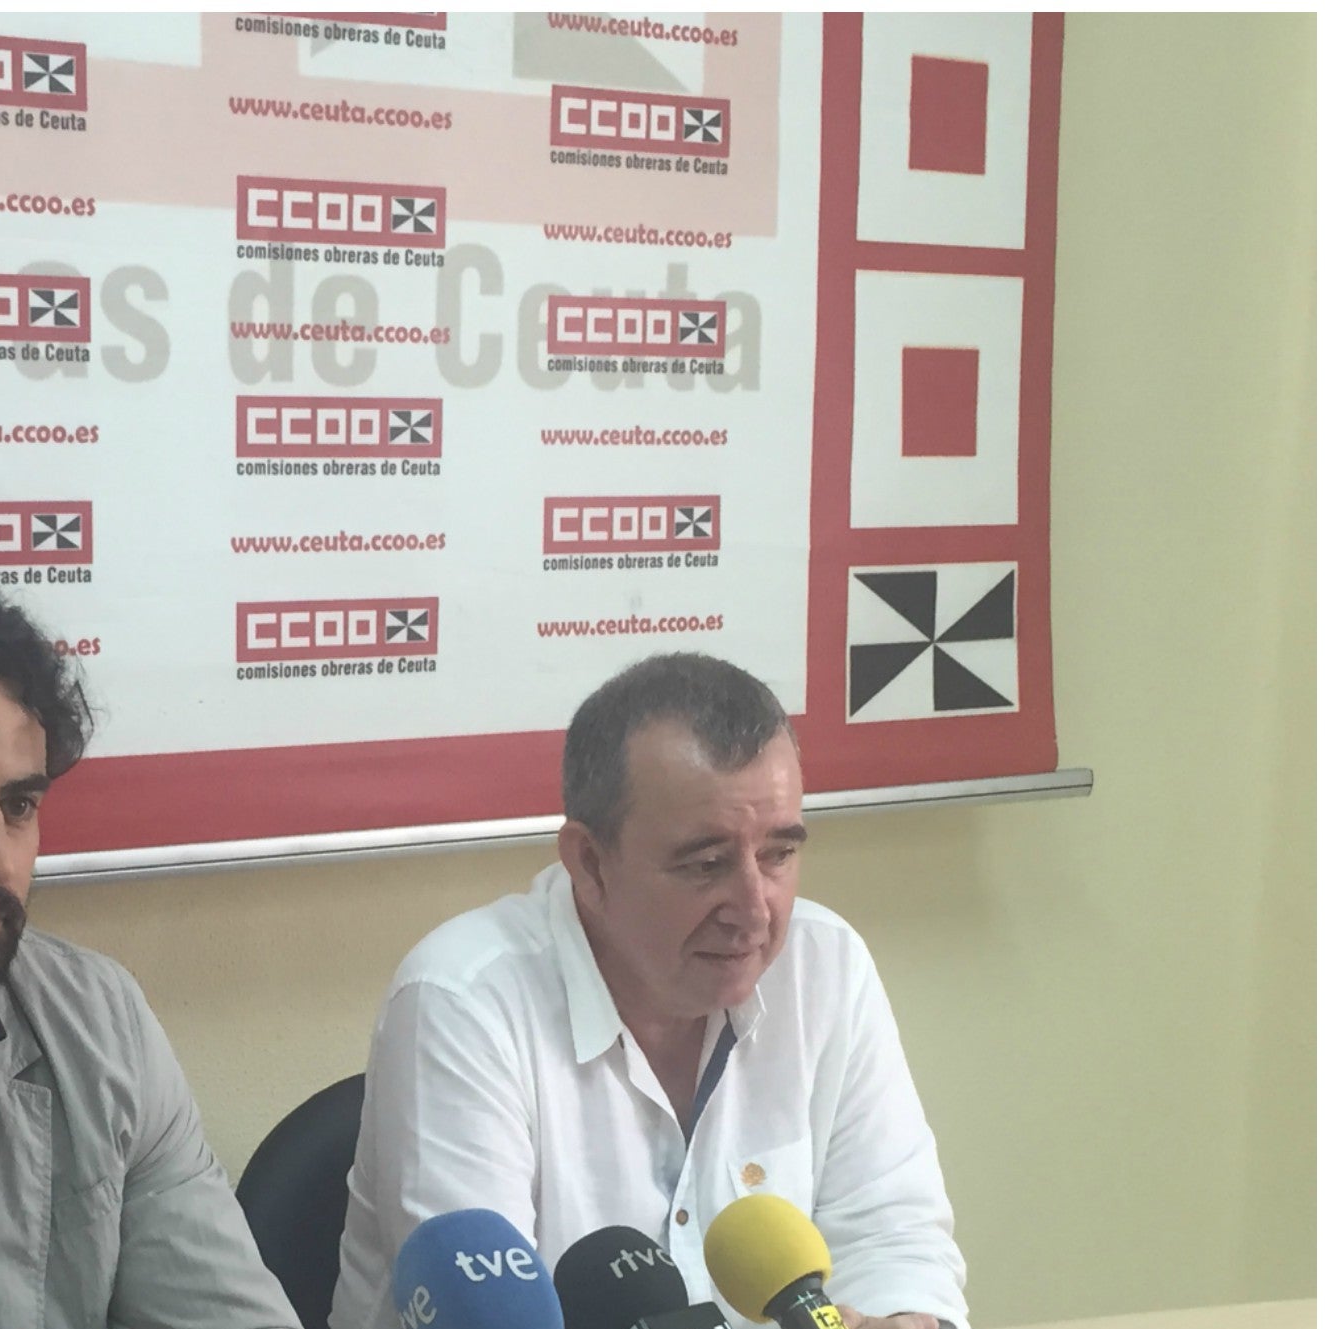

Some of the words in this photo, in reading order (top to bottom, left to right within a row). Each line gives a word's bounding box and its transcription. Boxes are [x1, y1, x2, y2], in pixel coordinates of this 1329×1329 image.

[235, 18, 319, 39] comisiones
[323, 23, 380, 44] obreras
[383, 27, 402, 46] de
[406, 29, 447, 50] Ceuta
[547, 12, 738, 48] www.ceuta.ccoo.es
[15, 107, 35, 128] de
[39, 109, 87, 131] Ceuta
[229, 97, 452, 130] www.ceuta.ccoo.es
[560, 97, 675, 141] CCOO
[550, 149, 622, 169] comisiones
[625, 154, 673, 172] obreras
[675, 156, 690, 173] de
[693, 157, 730, 175] Ceuta
[247, 189, 381, 232] CCOO
[544, 222, 733, 249] www.ceuta.ccoo.es
[236, 243, 321, 262] comisiones
[324, 246, 379, 265] obreras
[383, 249, 402, 266] de
[404, 250, 446, 268] Ceuta
[231, 320, 451, 345] www.ceuta.ccoo.es
[557, 307, 671, 343] CCOO
[21, 343, 40, 361] de
[45, 344, 91, 363] Ceuta
[547, 357, 619, 373] comisiones
[621, 358, 670, 374] obreras
[671, 359, 688, 374] de
[689, 359, 725, 375] Ceuta
[247, 408, 380, 445] CCOO
[541, 426, 728, 446] www.ceuta.ccoo.es
[236, 459, 318, 476] comisiones
[322, 459, 377, 476] obreras
[380, 459, 397, 476] de
[400, 460, 441, 476] Ceuta
[552, 507, 666, 541] CCOO
[230, 531, 446, 554] www.ceuta.ccoo.es
[543, 555, 614, 571] comisiones
[617, 554, 664, 570] obreras
[667, 554, 682, 568] de
[684, 554, 719, 568] Ceuta
[23, 568, 42, 584] de
[47, 568, 92, 584] Ceuta
[247, 610, 376, 649] CCOO
[537, 614, 724, 637] www.ceuta.ccoo.es
[236, 662, 317, 681] comisiones
[321, 660, 374, 677] obreras
[377, 659, 394, 674] de
[396, 658, 437, 674] Ceuta
[454, 1247, 539, 1282] tve
